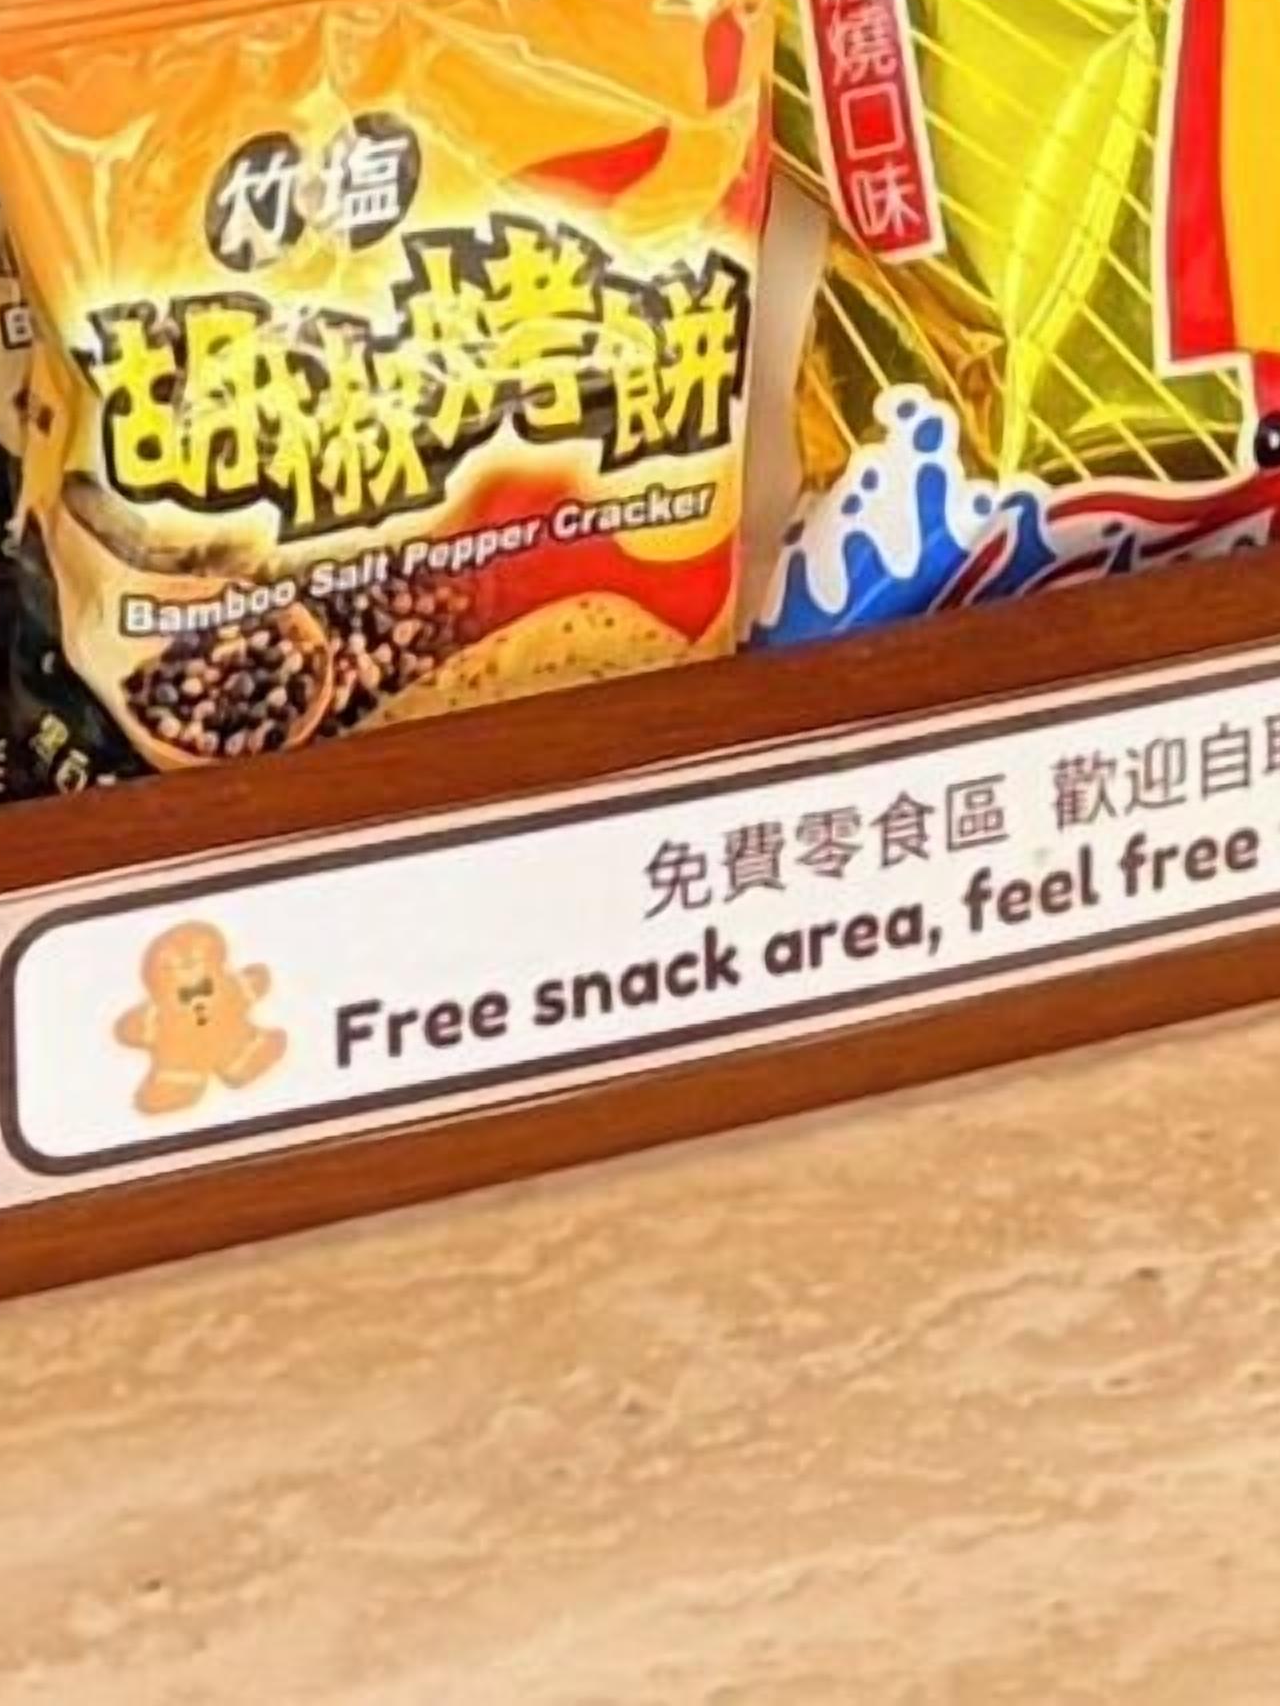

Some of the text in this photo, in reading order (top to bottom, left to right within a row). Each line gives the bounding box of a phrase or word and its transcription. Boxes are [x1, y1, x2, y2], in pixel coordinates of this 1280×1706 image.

[86, 212, 751, 537] 胡椒烤餅
[122, 482, 717, 636] Bamboo Salt Pepper Cracker
[644, 772, 1010, 919] 免費零食區
[335, 998, 510, 1069] Free
[533, 925, 740, 1026] snack
[763, 902, 942, 976] area,
[962, 844, 1100, 933] feel
[1119, 832, 1261, 896] free
